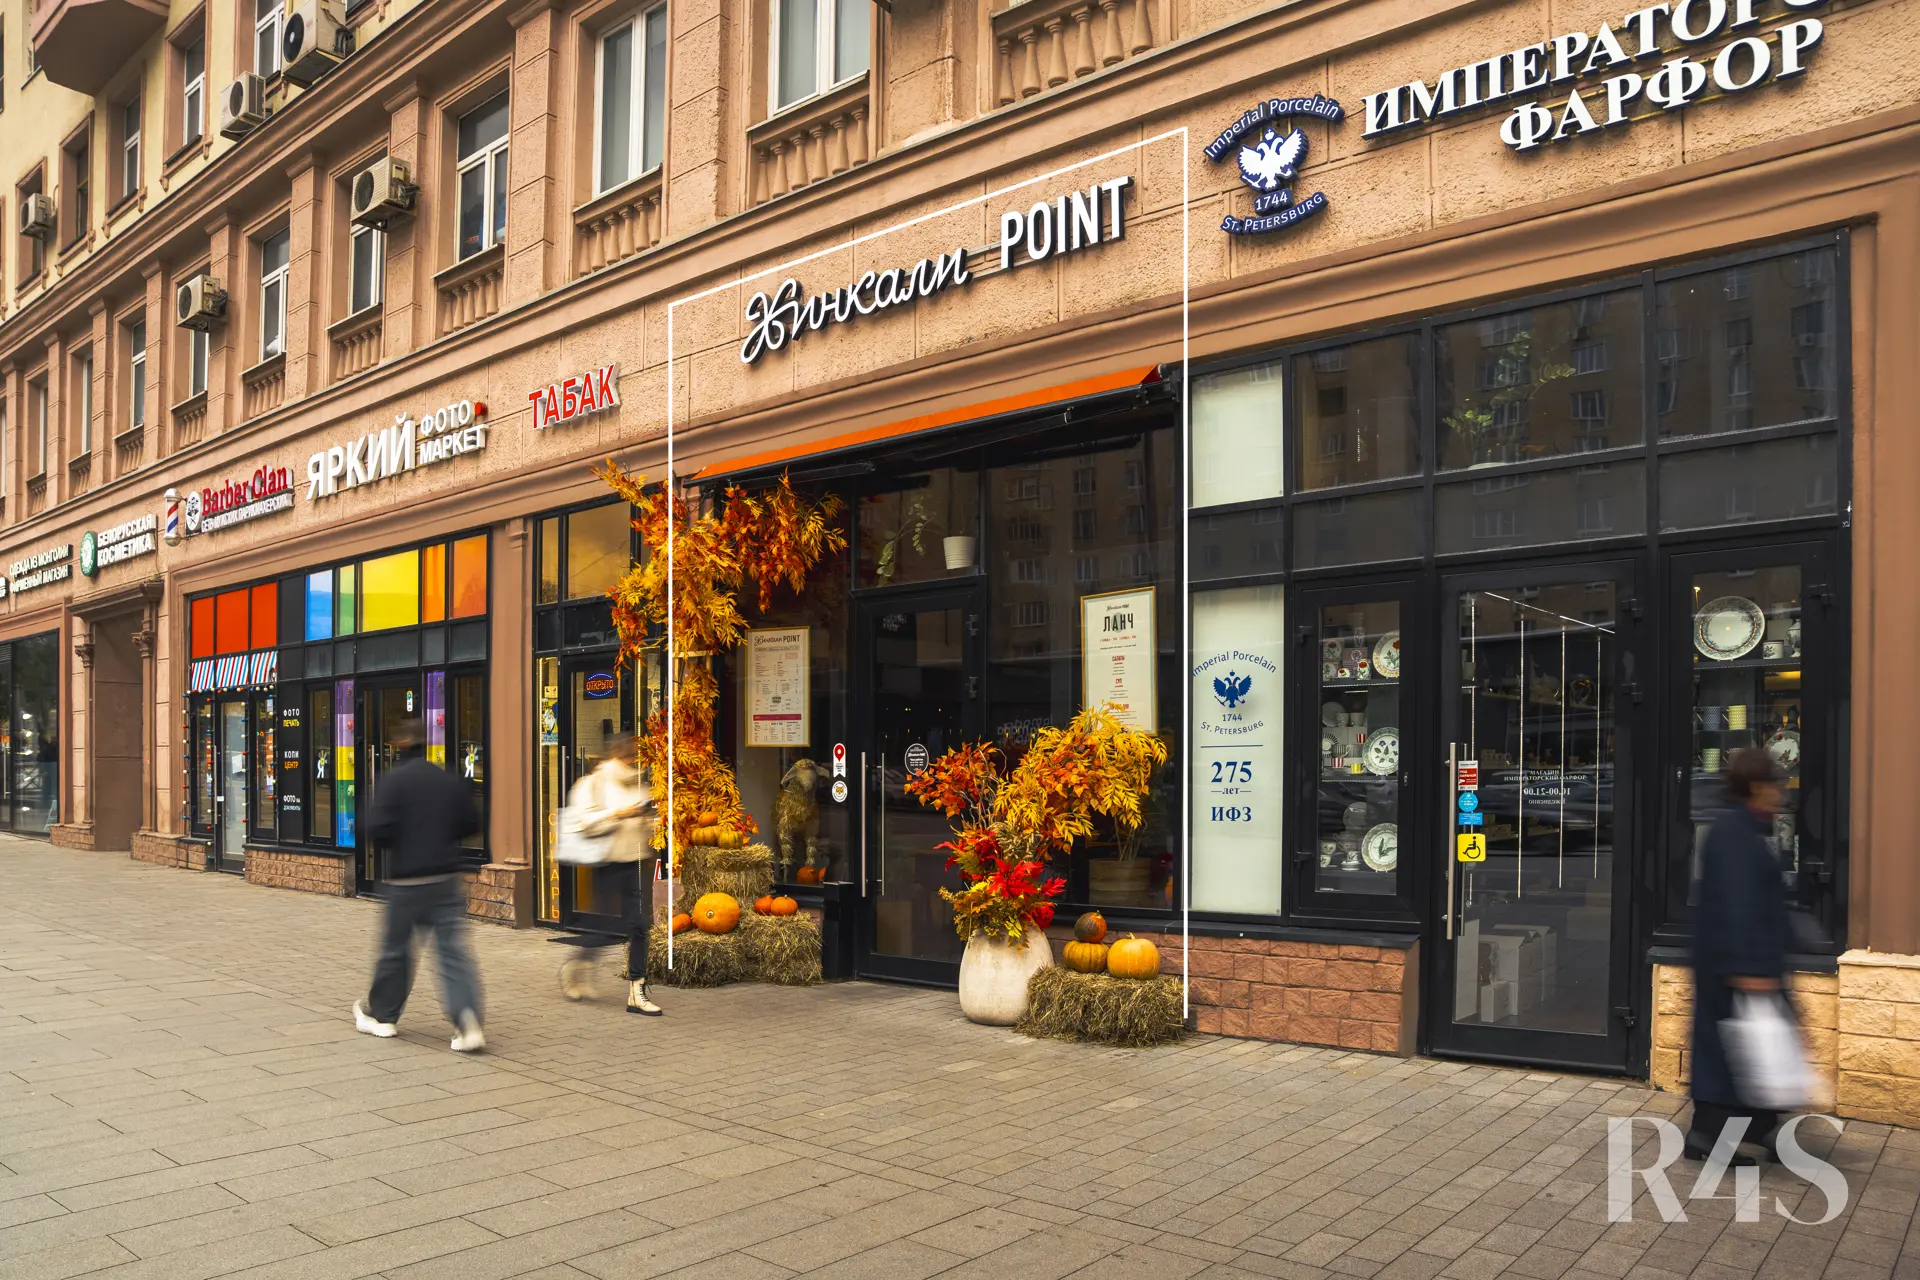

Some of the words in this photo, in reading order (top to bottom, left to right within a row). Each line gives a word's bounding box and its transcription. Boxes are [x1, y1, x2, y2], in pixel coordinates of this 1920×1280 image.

[1361, 0, 1819, 139] ИМПЕРАТО
[1499, 18, 1824, 151] ФАРФОР
[1204, 104, 1263, 158] Imperial
[1269, 96, 1339, 118] Porcelain
[1255, 191, 1288, 211] 1744
[740, 248, 972, 364] Хинкали
[1000, 175, 1131, 269] POINT
[528, 362, 616, 430] ТАБАК
[306, 412, 416, 500] ЯРКИЙ
[420, 399, 472, 436] ФОТО
[419, 423, 489, 465] МАРКЕТ
[202, 479, 249, 516] Barber
[252, 465, 288, 499] Clan
[97, 514, 153, 546] БЕЛОРУССКАЯ
[10, 558, 31, 579] ОДЕЖДА
[38, 544, 69, 567] МОНГОЛИИ
[97, 532, 153, 567] КОСМЕТИКА
[43, 564, 69, 589] МАГАЗИН
[1103, 613, 1134, 632] ЛАНЧ
[783, 635, 800, 643] POINT
[1192, 651, 1230, 677] mperial
[1233, 650, 1277, 673] Porcelain
[586, 680, 615, 691] ОТКРЫТО
[283, 708, 300, 717] ФОТО
[283, 719, 300, 727] ПЕЧАТЬ
[1222, 714, 1243, 722] 1744
[284, 761, 299, 770] ЦЕНТР
[1211, 760, 1253, 783] 275
[283, 795, 296, 803] ФОТО
[1211, 806, 1252, 822] ИФЗ
